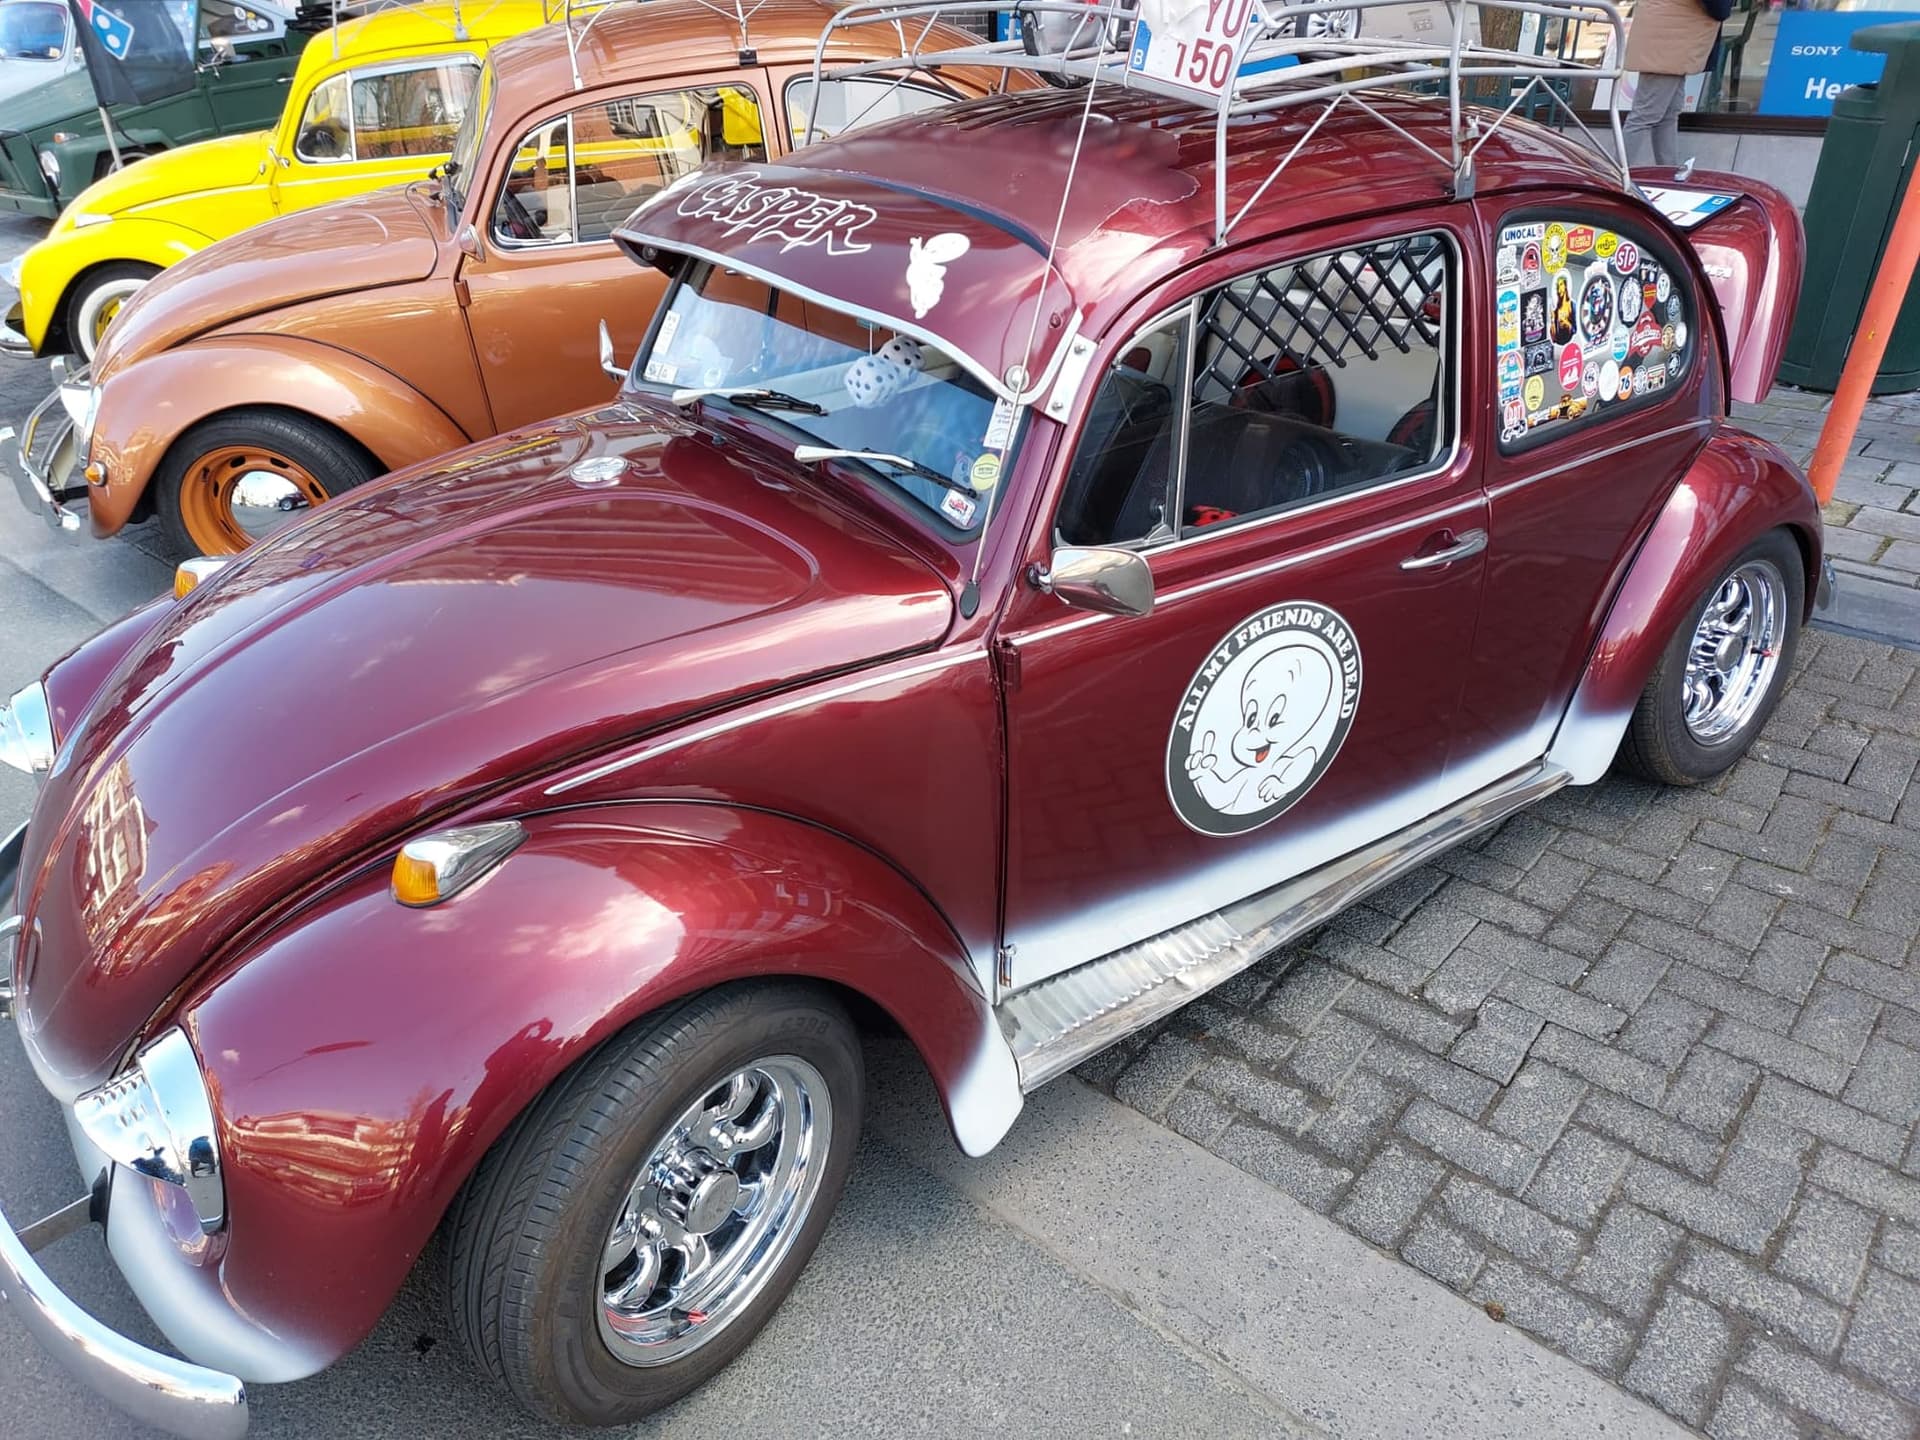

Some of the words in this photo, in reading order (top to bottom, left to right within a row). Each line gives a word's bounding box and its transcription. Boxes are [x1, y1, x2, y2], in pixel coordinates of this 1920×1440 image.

[1133, 49, 1144, 65] B
[1791, 45, 1842, 56] SONY
[1174, 38, 1233, 88] 150
[677, 171, 878, 256] CASPER
[1504, 227, 1537, 241] UNOCAL
[1617, 245, 1636, 269] STP
[1620, 375, 1631, 391] 76
[1178, 685, 1208, 732] ALL
[1202, 645, 1234, 682] MY
[1234, 608, 1325, 649] FRIENDS
[1321, 620, 1353, 657] ARE
[1340, 654, 1358, 720] DEAD
